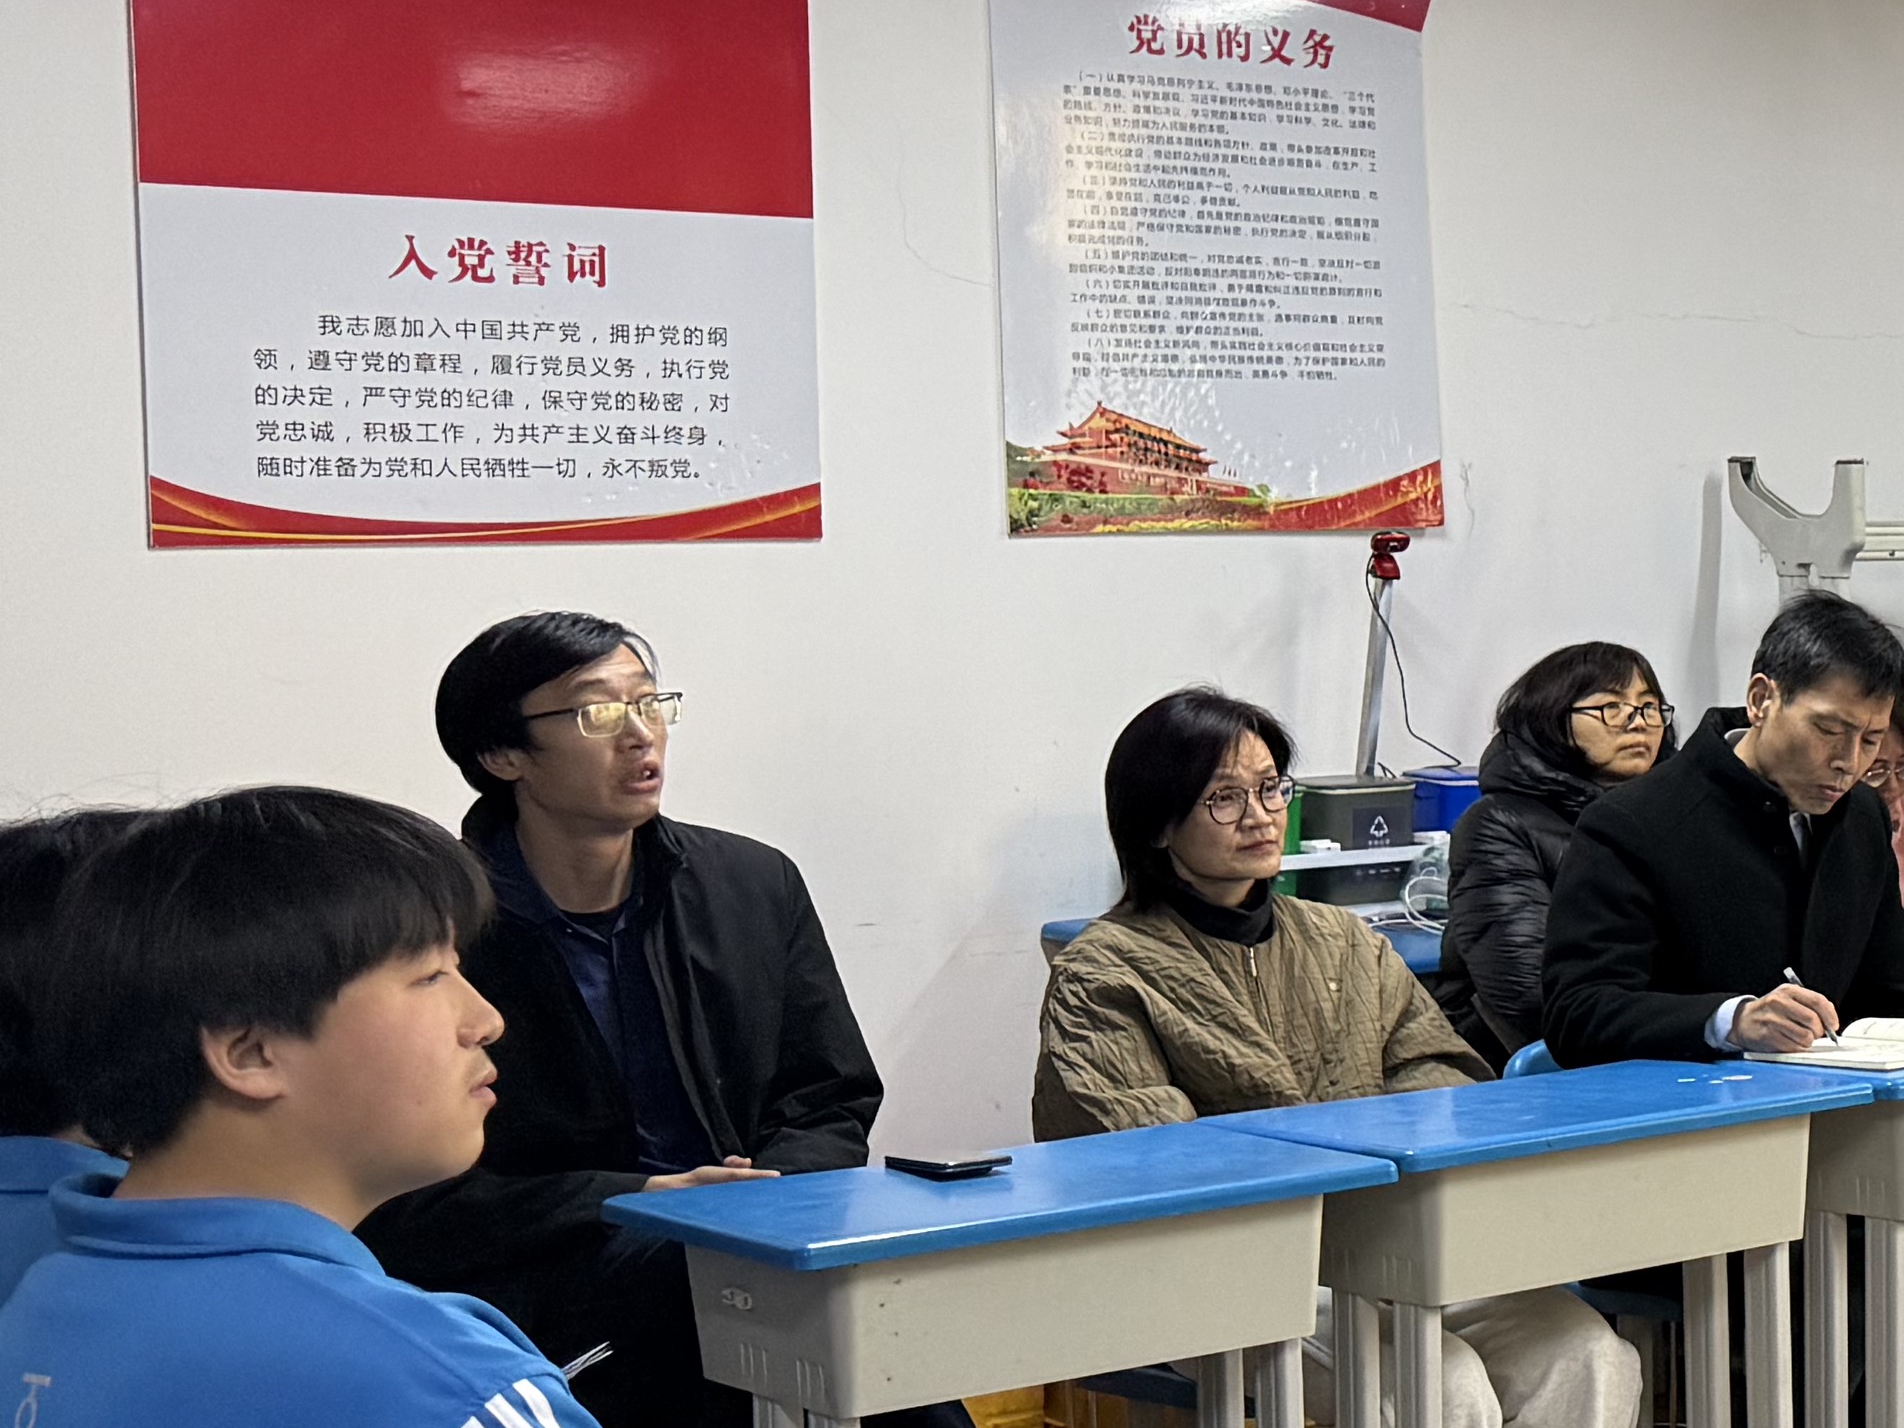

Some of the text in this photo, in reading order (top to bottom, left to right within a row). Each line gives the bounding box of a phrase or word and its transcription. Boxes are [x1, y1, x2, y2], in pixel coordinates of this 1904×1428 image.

[1128, 14, 1335, 70] 党员的义务
[388, 235, 606, 288] 入党誓词
[318, 315, 727, 347] 我志愿加入中国共产党，拥护党的纲
[253, 348, 729, 380] 领，遵守党的章程，履行党员义务，执行党
[255, 384, 730, 413] 的决定，严守党的纪律，保守党的秘密，对
[256, 420, 725, 447] 党忠诚，积极工作，为共产主义奋斗终身，
[257, 456, 699, 479] 随时准备为党和人民牺牲一切，永不叛党。
